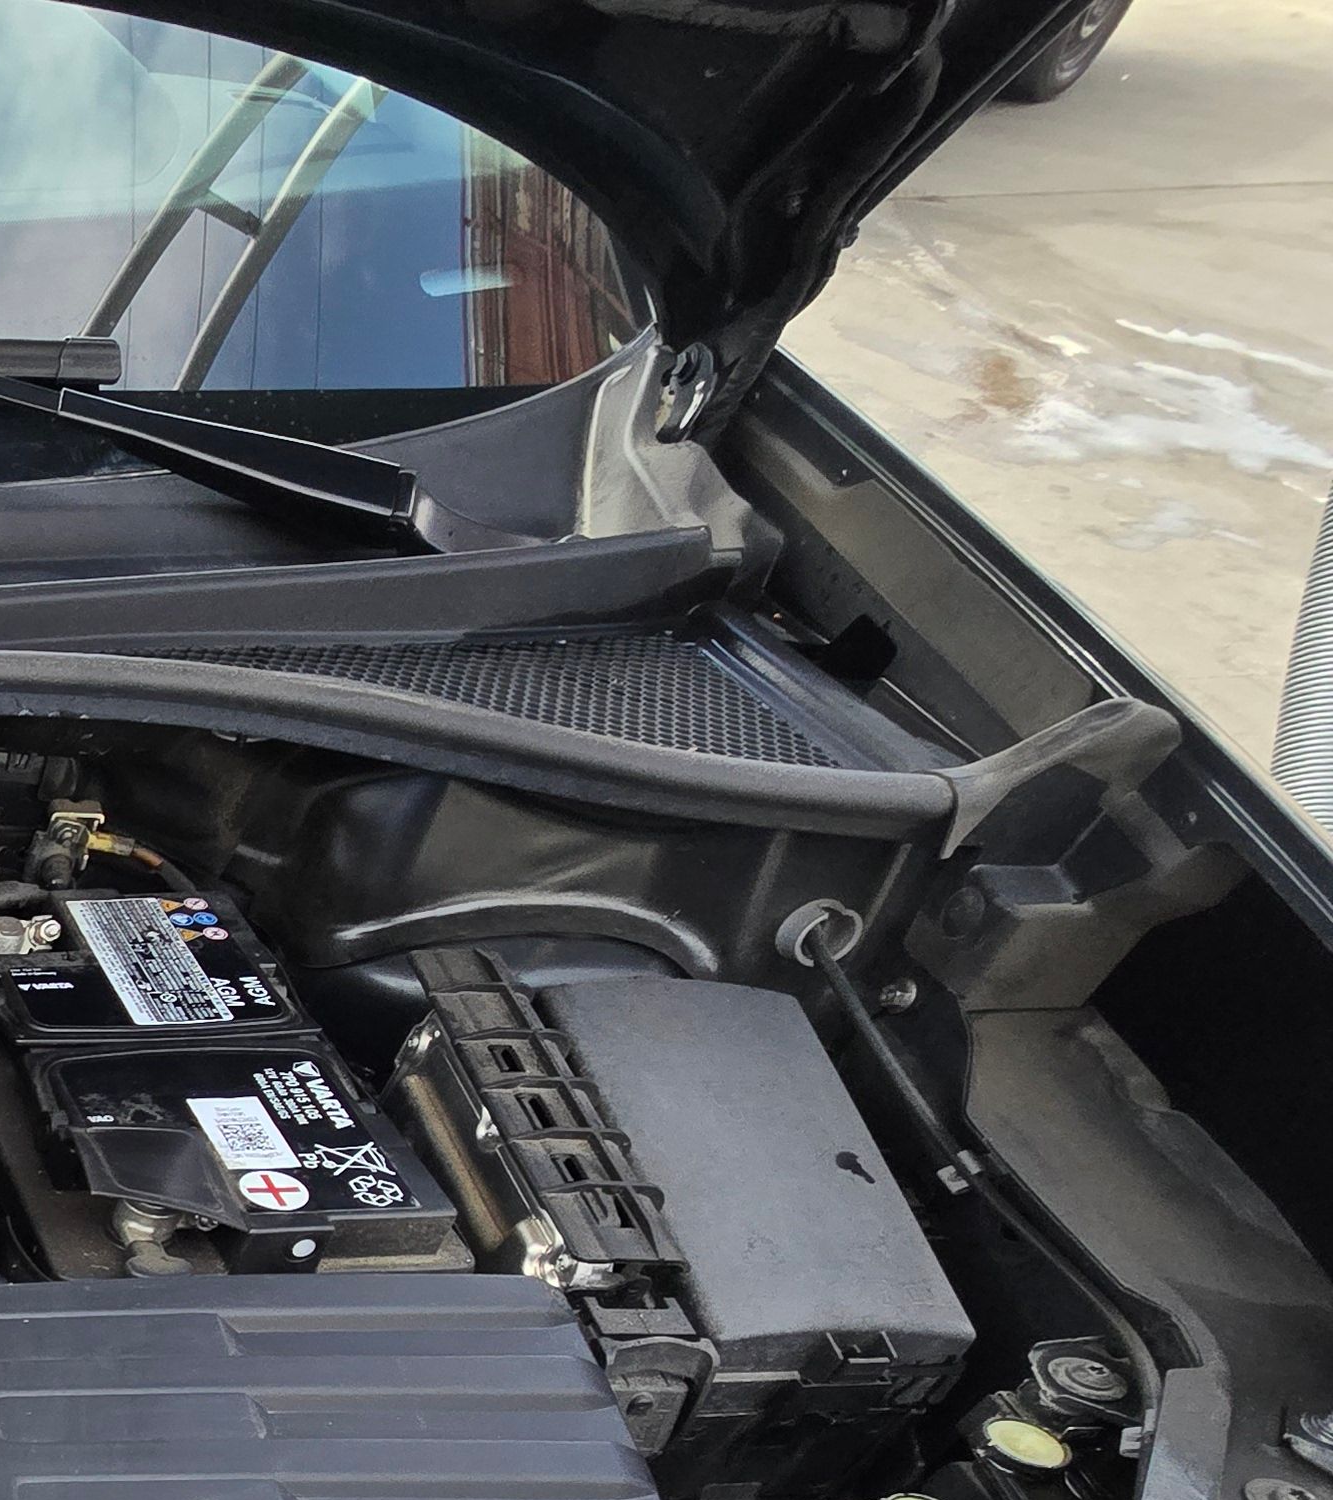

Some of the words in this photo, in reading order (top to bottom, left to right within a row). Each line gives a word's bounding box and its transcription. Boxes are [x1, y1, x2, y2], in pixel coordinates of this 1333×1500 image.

[210, 978, 245, 1006] AGM
[239, 976, 276, 1006] AGM
[279, 1071, 299, 1086] 7P0
[290, 1088, 308, 1102] 915
[306, 1078, 355, 1129] VARTA
[298, 1153, 319, 1169] Pb
